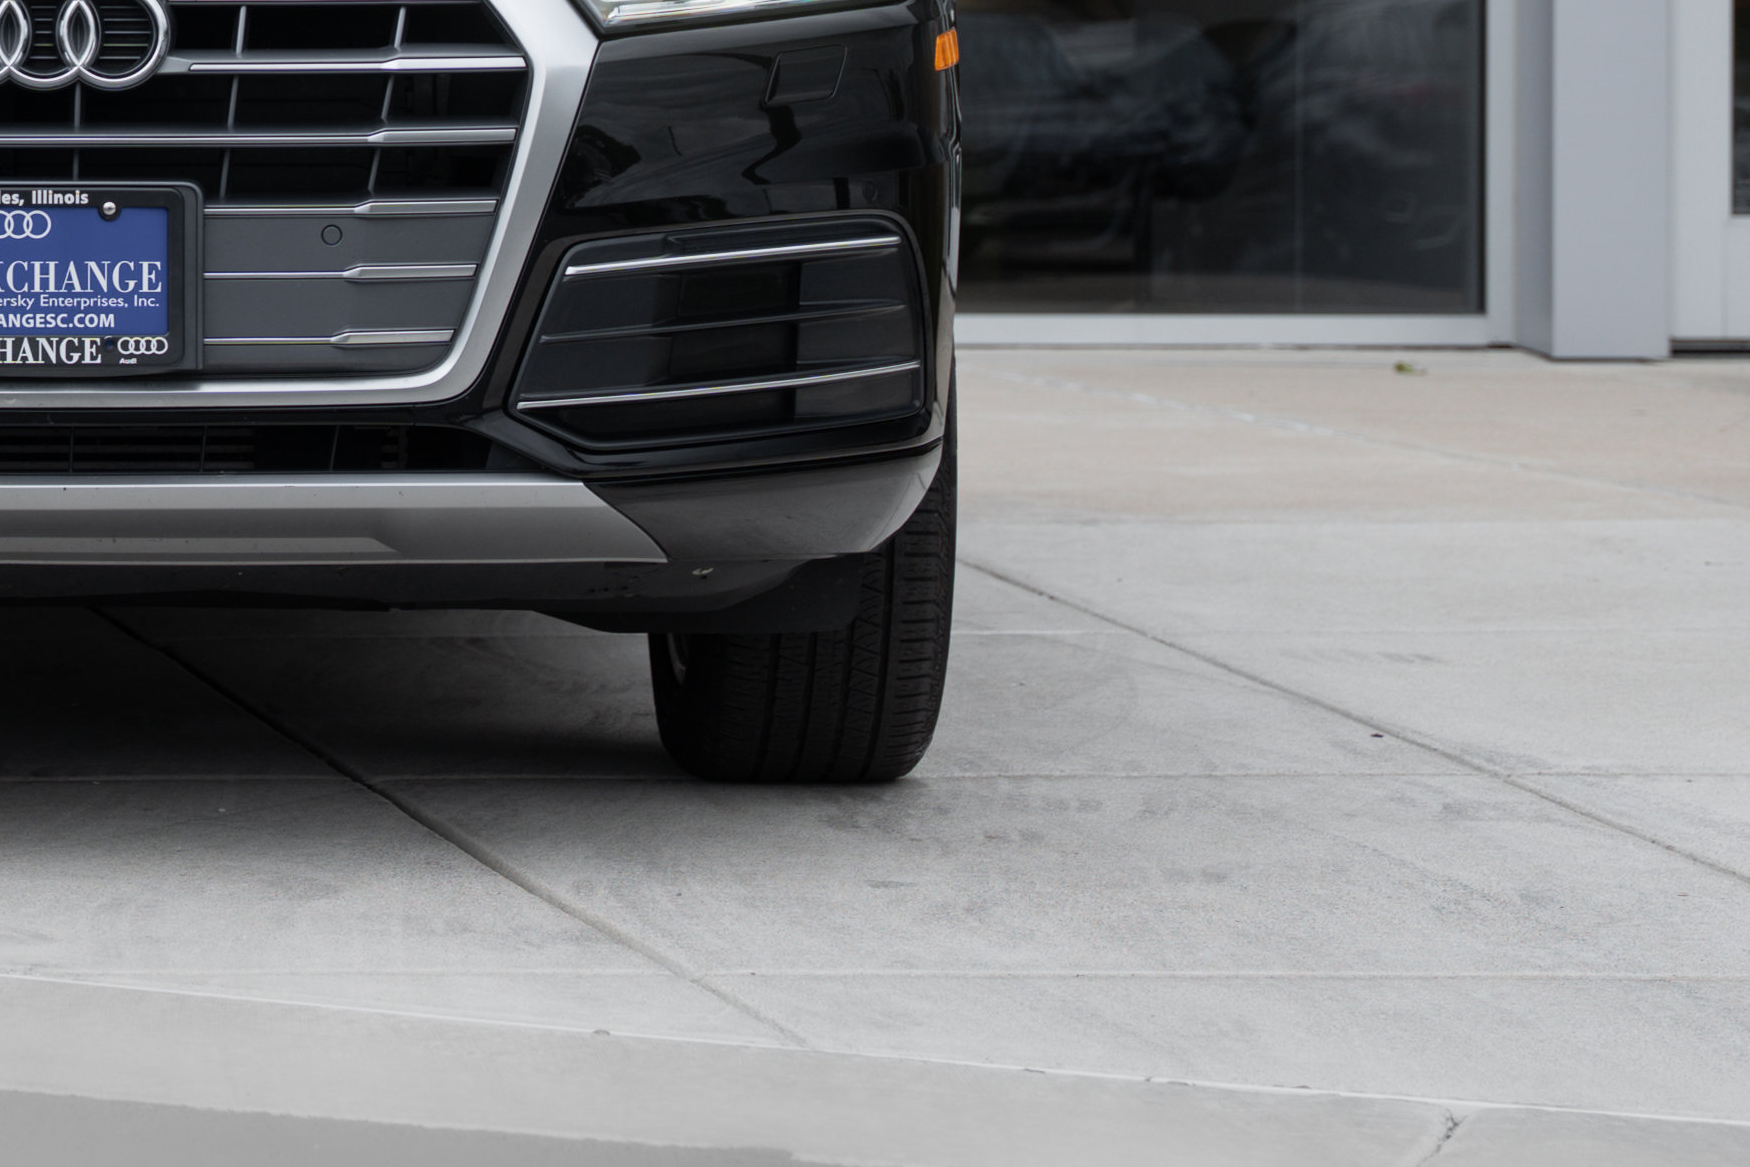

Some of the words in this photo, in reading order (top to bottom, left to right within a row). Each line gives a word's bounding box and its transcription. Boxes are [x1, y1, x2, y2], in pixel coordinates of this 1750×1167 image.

[31, 189, 89, 205] Illinois
[40, 294, 128, 310] Enterprises,
[134, 294, 159, 307] Inc.
